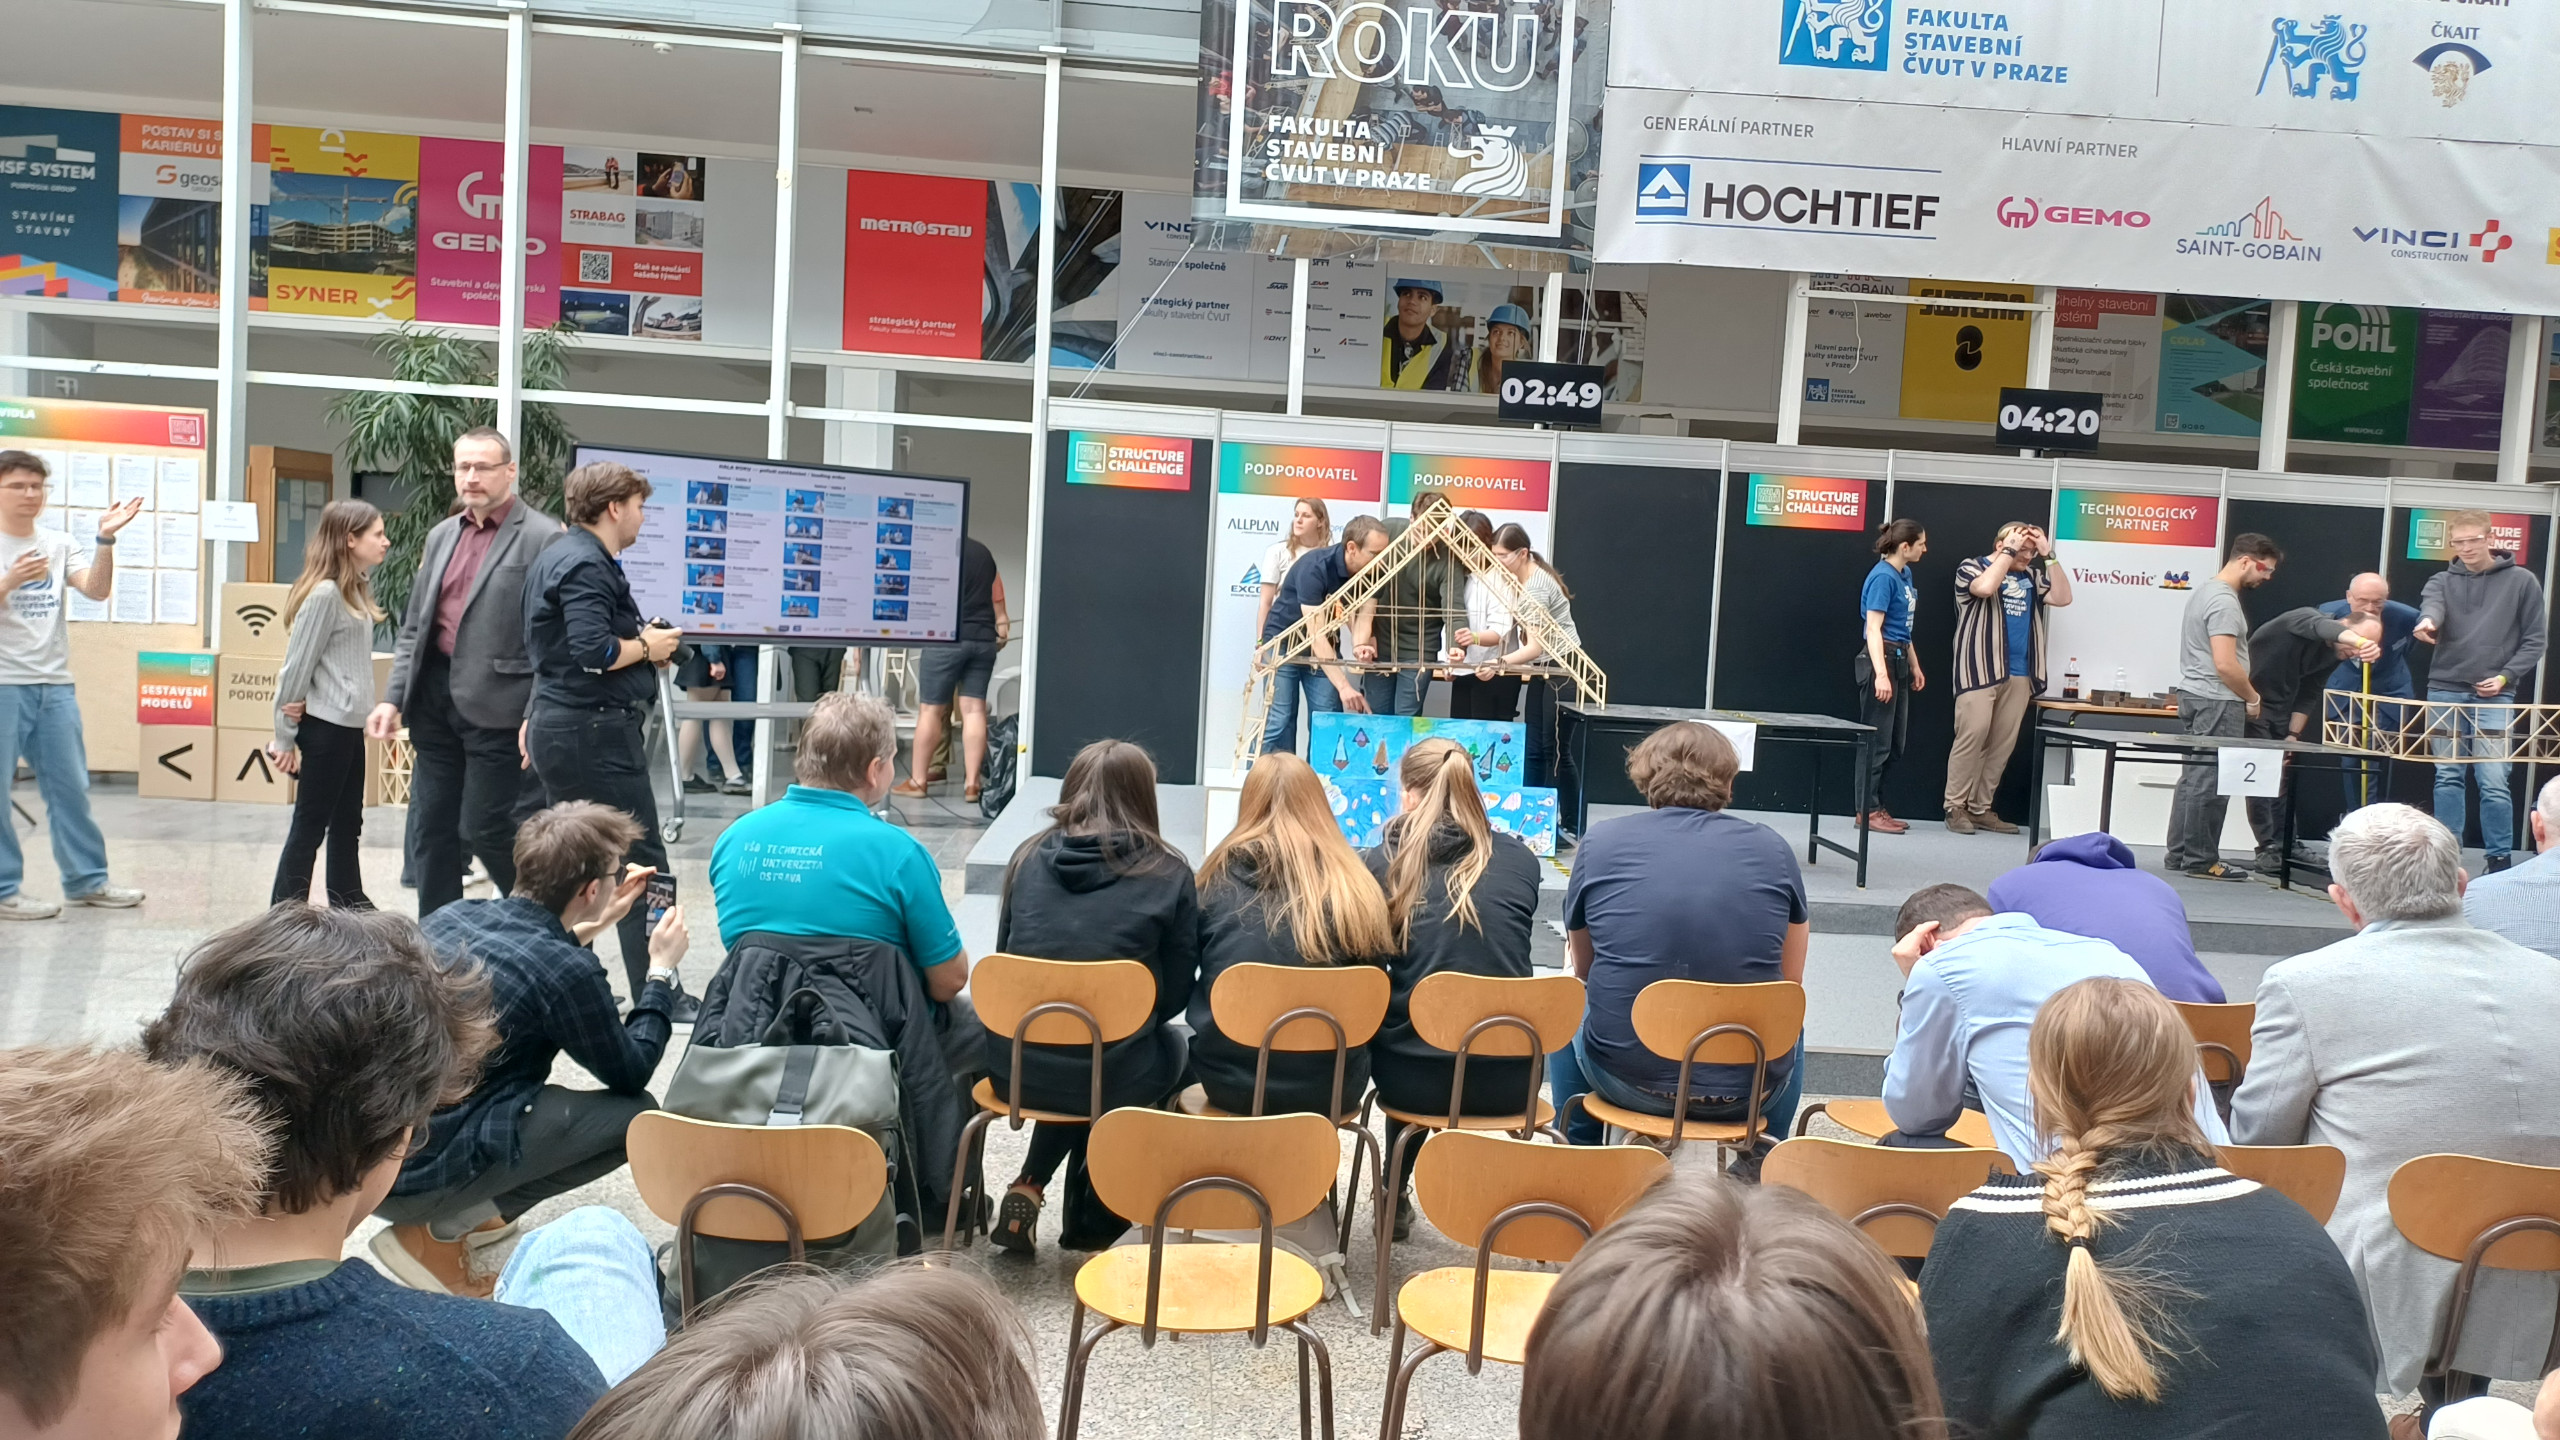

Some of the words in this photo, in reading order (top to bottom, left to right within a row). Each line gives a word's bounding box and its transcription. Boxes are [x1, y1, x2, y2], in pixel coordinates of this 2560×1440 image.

[1906, 7, 2009, 32] FAKULTA
[2430, 21, 2480, 40] ČKAIT
[1904, 32, 2024, 57] STAVEBNÍ
[1903, 53, 1963, 78] ČVUT
[1970, 60, 1986, 78] V
[1993, 62, 2069, 84] PRAZE
[141, 124, 195, 139] POSTAV
[197, 129, 211, 140] SI
[1268, 115, 1371, 139] FAKULTA
[1643, 115, 1736, 134] GENERÁLNÍ
[1740, 120, 1814, 139] PARTNER
[141, 139, 202, 154] KARIÉRU
[206, 144, 216, 155] U
[1266, 137, 1386, 164] STAVEBNÍ
[2002, 136, 2061, 155] HLAVNÍ
[2066, 141, 2138, 159] PARTNER
[29, 162, 96, 180] SYSTEM
[1265, 161, 1327, 185] ČVUT
[1334, 166, 1350, 185] V
[1355, 167, 1431, 190] PRAZE
[180, 173, 222, 188] geos
[1703, 182, 1940, 231] HOCHTIEF
[11, 210, 76, 223] STAVÍME
[569, 209, 626, 223] STRABAG
[2044, 204, 2151, 229] GEMO
[15, 224, 71, 236] STAVBY
[2352, 226, 2459, 249] VINCI
[2175, 238, 2322, 262] SAINT-GOBAIN
[2391, 249, 2469, 263] CONSTRUCTION
[1185, 261, 1226, 271] společně
[474, 280, 481, 289] a
[276, 284, 358, 305] SYNER
[462, 291, 501, 301] společn
[1195, 300, 1230, 310] partner
[2098, 298, 2150, 311] stavební
[869, 316, 920, 328] strategický
[922, 320, 956, 329] partner
[1170, 310, 1205, 320] stavební
[1207, 310, 1231, 322] ČVUT
[2055, 311, 2092, 323] ystém
[2128, 339, 2146, 348] bloky
[2311, 322, 2397, 353] POHL
[1814, 343, 1837, 351] Hlavní
[1859, 353, 1878, 362] ČVUT
[2309, 359, 2342, 374] Česká
[2345, 364, 2393, 376] stavební
[2308, 378, 2369, 391] společnost
[1501, 377, 1602, 409] 02:49
[1999, 404, 2100, 435] 04:20
[1109, 446, 1184, 463] STRUCTURE
[1108, 460, 1184, 475] CHALLENGE
[1244, 462, 1359, 481] PODPOROVATEL
[1413, 473, 1527, 491] PODPOROVATEL
[1786, 489, 1859, 504] STRUCTURE
[1785, 502, 1858, 516] CHALLENGE
[2079, 503, 2197, 521] TECHNOLOGICKÝ
[1227, 518, 1279, 532] ALLPLAN
[2105, 517, 2170, 532] PARTNER
[2072, 567, 2154, 587] ViewSonic
[231, 672, 277, 686] ZÁZEMÍ
[141, 685, 208, 697] SESTAVENÍ
[141, 697, 193, 709] MODELŮ
[2243, 762, 2257, 783] 2
[767, 844, 824, 856] TECHNICKÁ
[762, 857, 823, 870] UNIVERZITA
[759, 872, 801, 883] OSTRAVA
